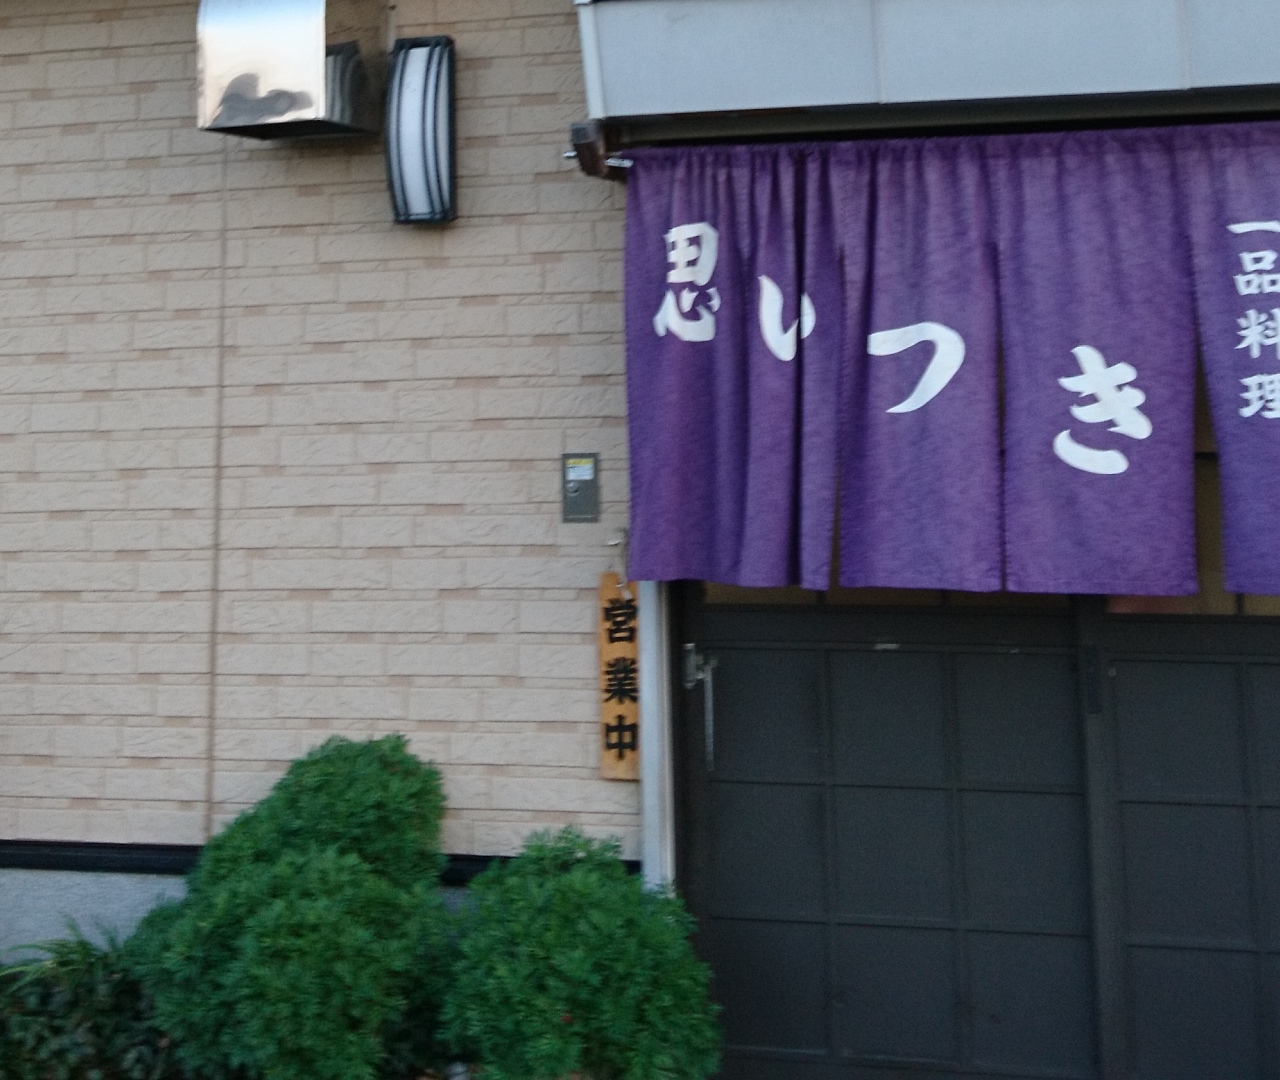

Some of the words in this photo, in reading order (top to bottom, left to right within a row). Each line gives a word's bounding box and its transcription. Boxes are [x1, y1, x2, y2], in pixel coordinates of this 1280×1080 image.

[653, 221, 1153, 475] 思いつき
[603, 596, 639, 761] 営業中
